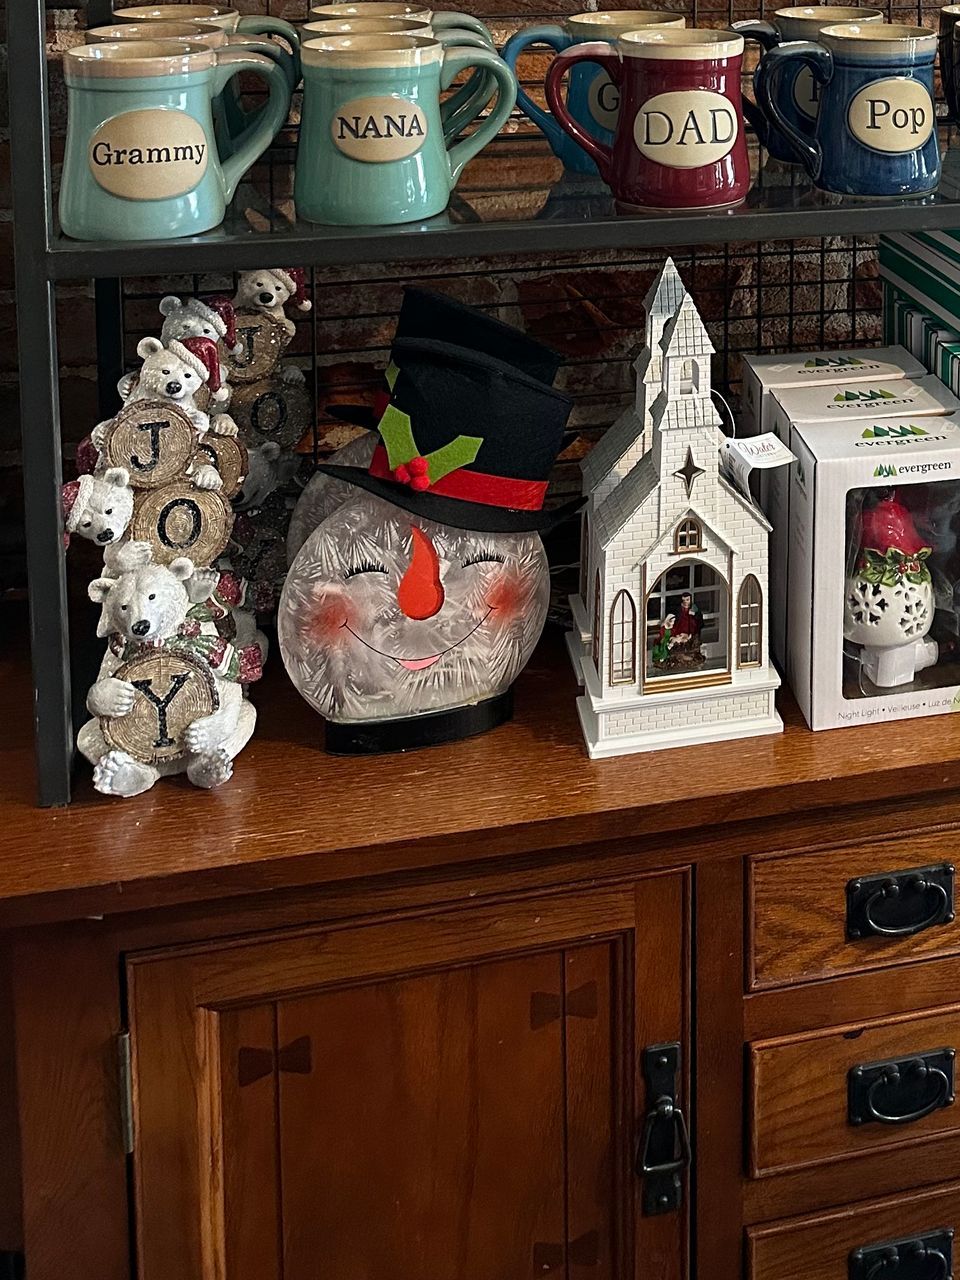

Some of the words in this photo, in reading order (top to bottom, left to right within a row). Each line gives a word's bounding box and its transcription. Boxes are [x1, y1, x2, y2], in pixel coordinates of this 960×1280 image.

[337, 113, 424, 139] NANA
[644, 108, 735, 147] DAD
[865, 99, 926, 135] Pop
[92, 141, 205, 166] Grammy
[797, 363, 881, 374] evergreen
[826, 397, 914, 409] evergreen
[129, 421, 170, 471] J
[855, 434, 947, 449] evergreen
[898, 461, 951, 475] evergreen
[157, 497, 202, 550] O
[131, 673, 188, 748] Y
[838, 710, 860, 720] Night
[861, 707, 880, 718] Light
